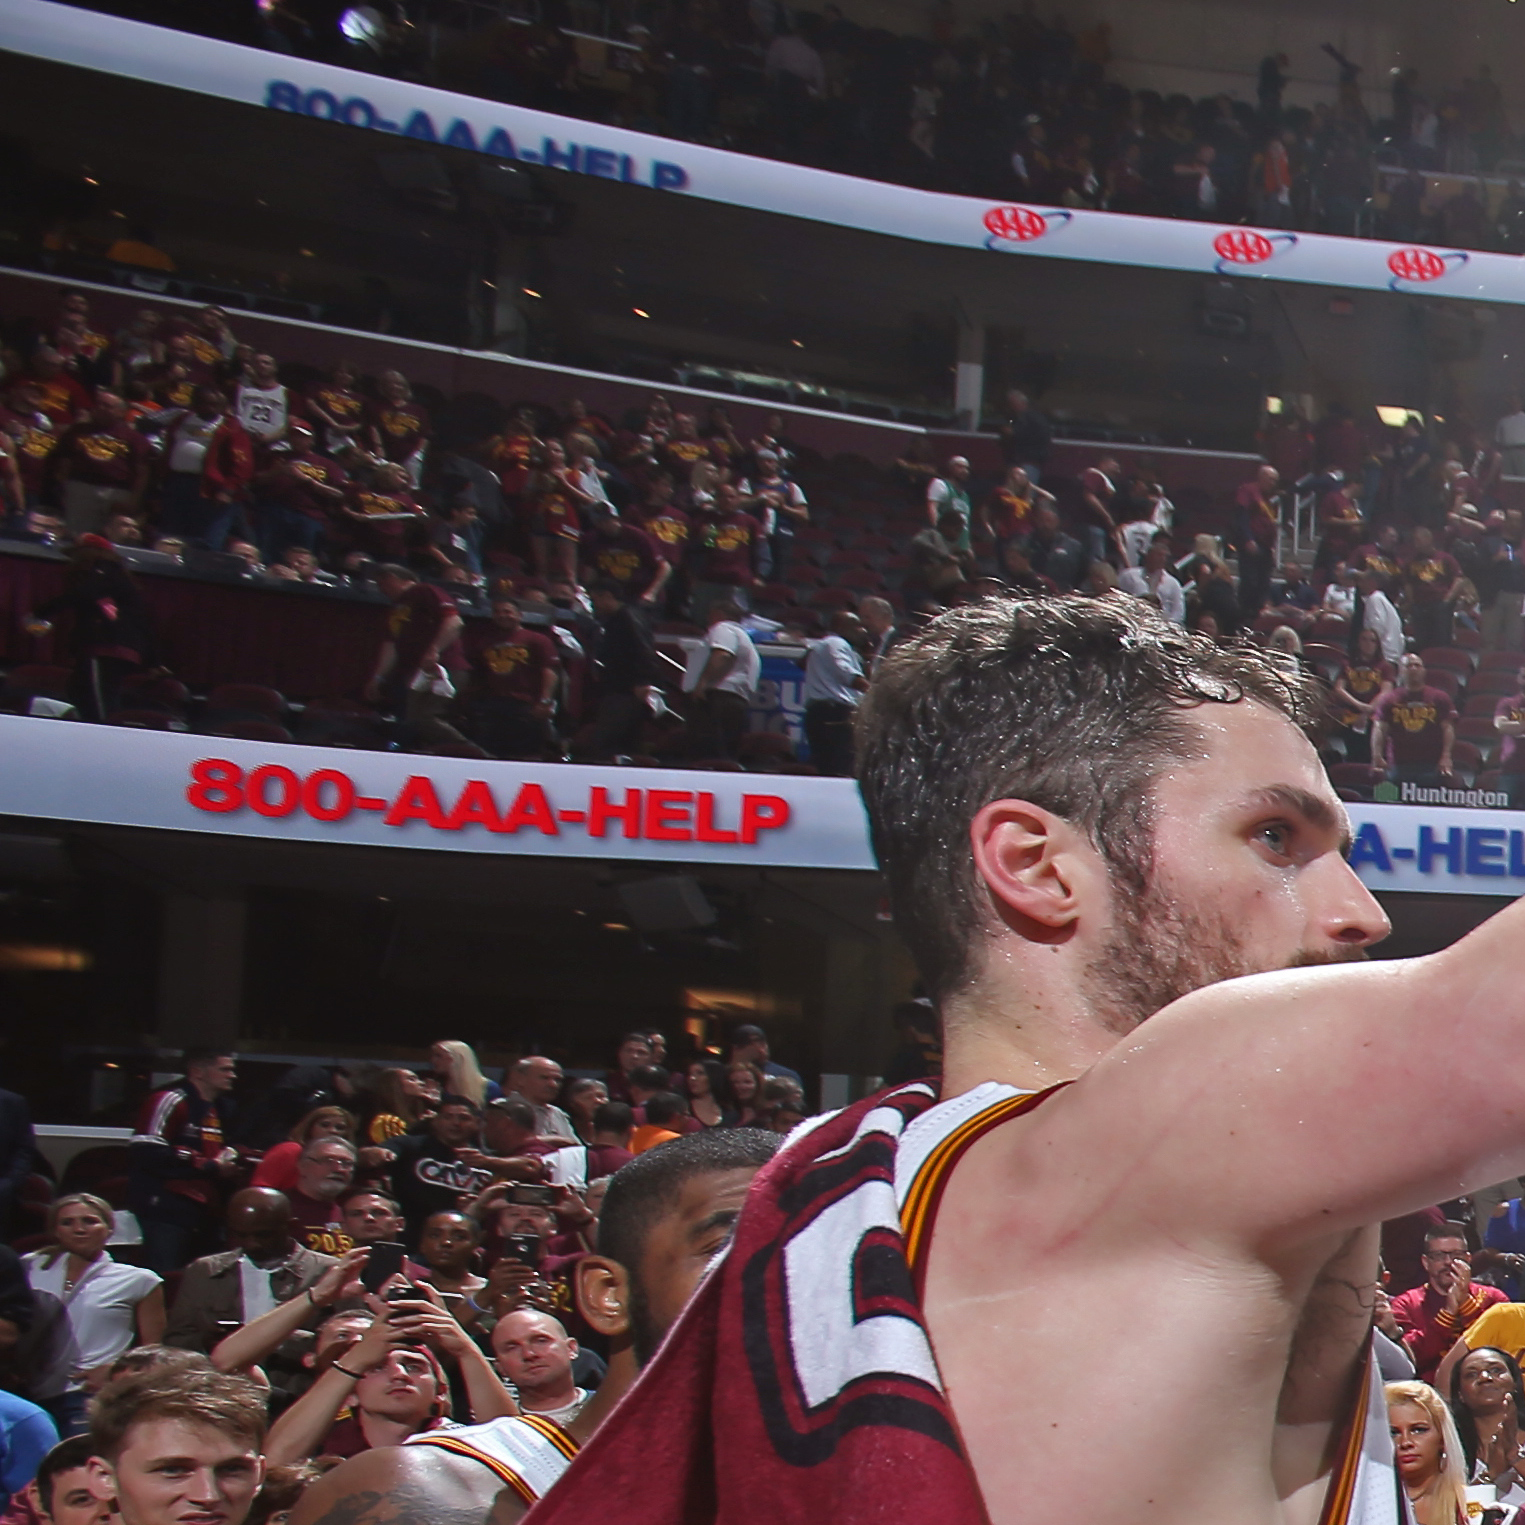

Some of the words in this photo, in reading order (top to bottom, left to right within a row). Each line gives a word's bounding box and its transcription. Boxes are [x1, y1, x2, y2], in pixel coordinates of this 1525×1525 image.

[265, 79, 690, 191] 800-AAA-HELP
[186, 757, 792, 846] 800-AAA-HELP
[1401, 781, 1508, 810] Huntington
